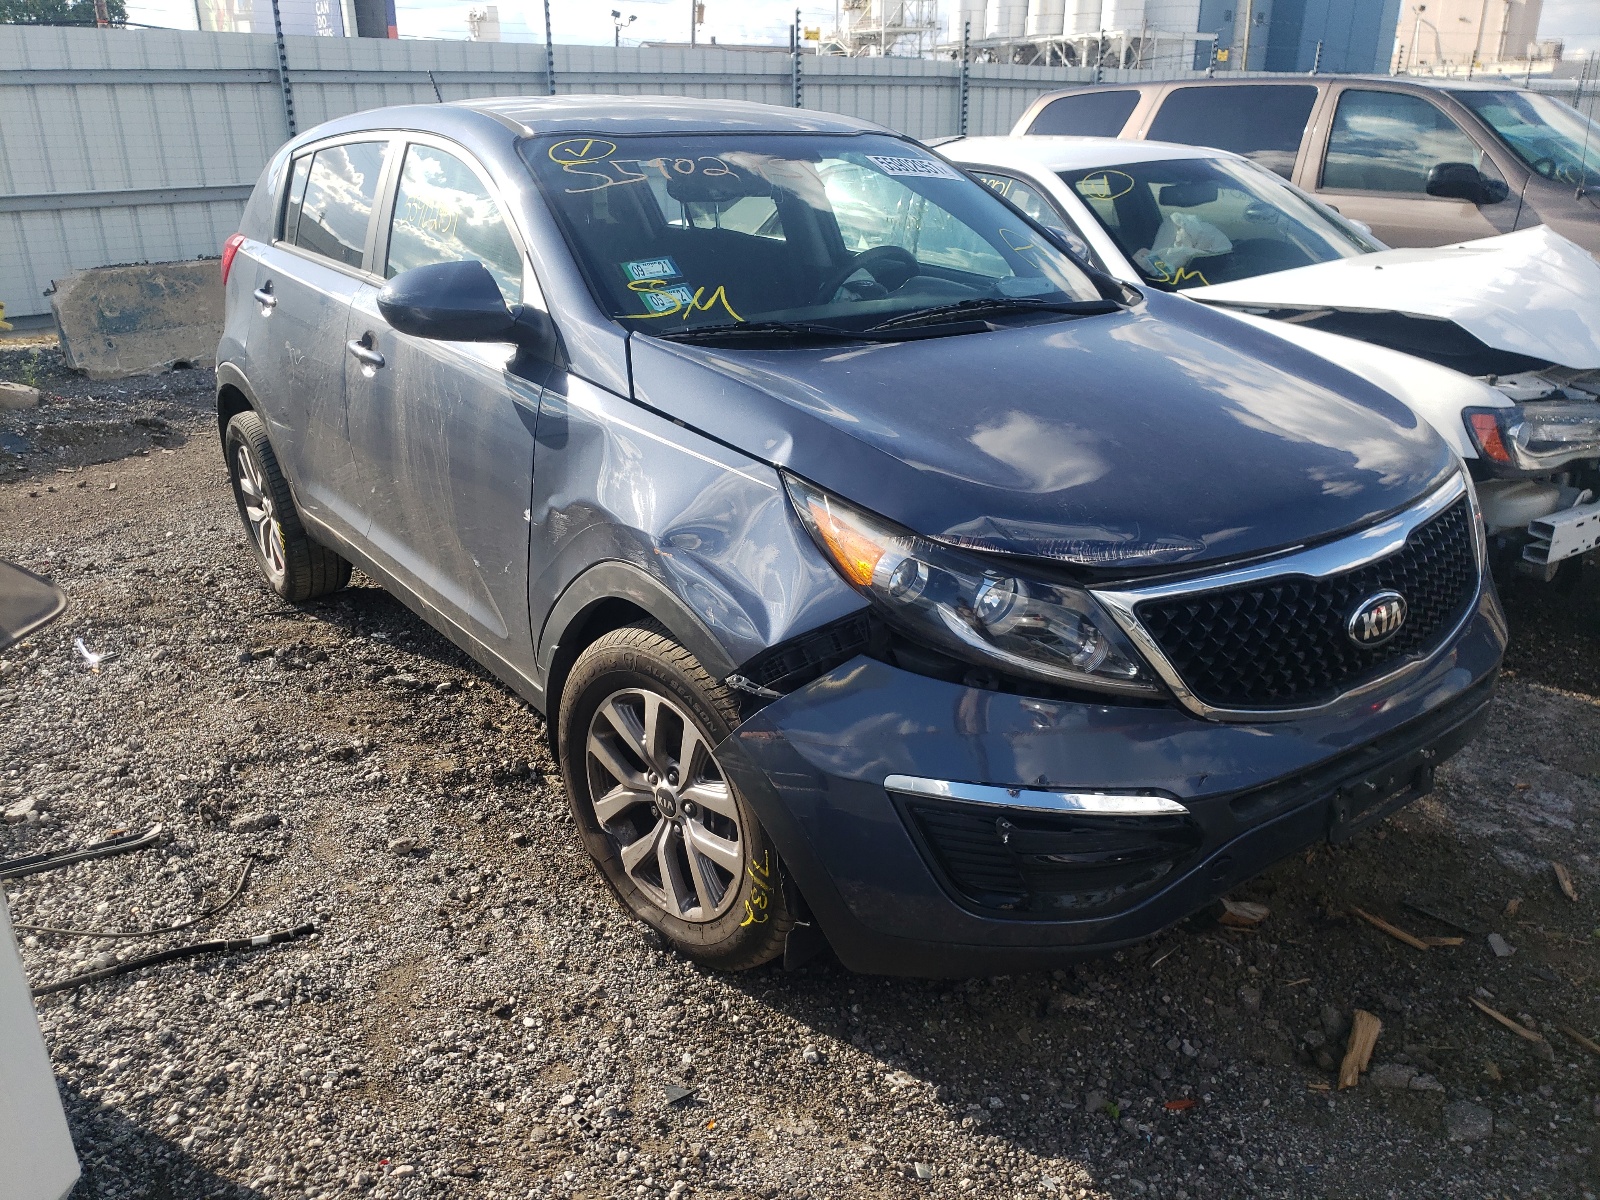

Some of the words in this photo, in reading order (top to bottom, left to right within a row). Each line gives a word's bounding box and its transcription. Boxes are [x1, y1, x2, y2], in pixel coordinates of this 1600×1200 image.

[315, 0, 330, 15] CAN
[317, 15, 327, 28] DO
[1361, 601, 1402, 640] KIA
[656, 794, 674, 811] KIA
